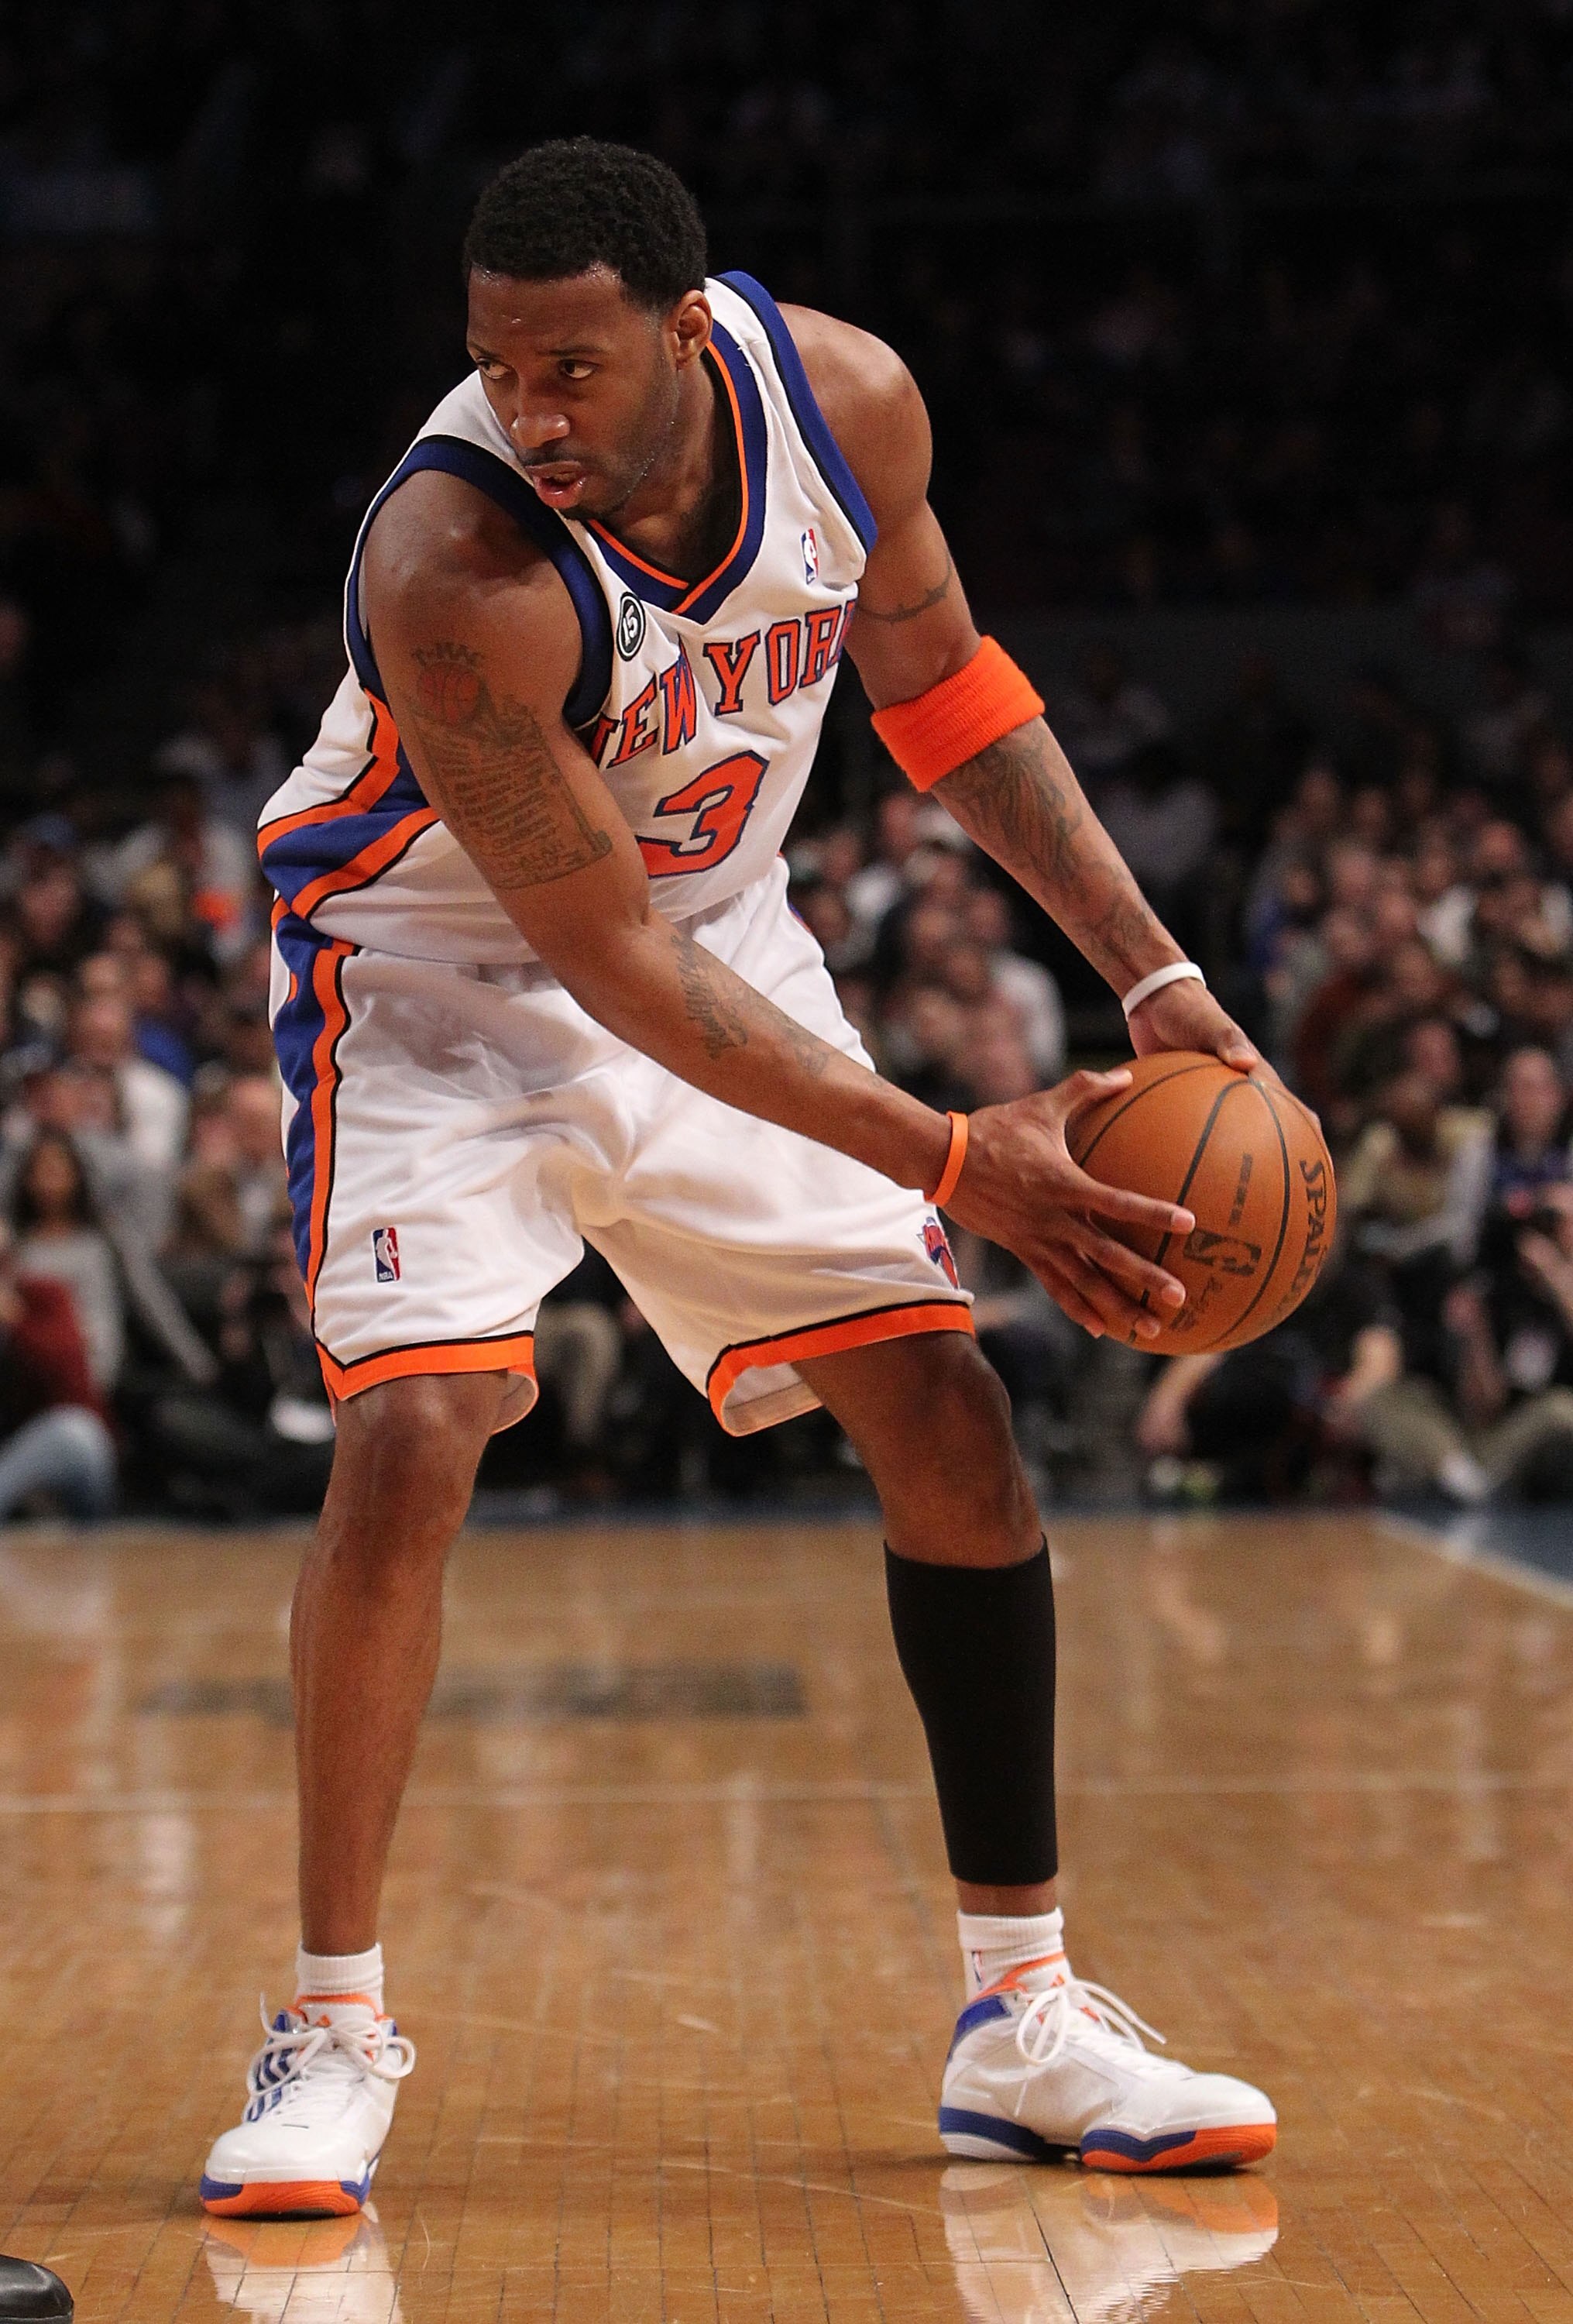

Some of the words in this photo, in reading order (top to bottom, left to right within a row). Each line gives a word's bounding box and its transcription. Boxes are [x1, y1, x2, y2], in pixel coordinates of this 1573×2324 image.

[623, 605, 638, 646] 15
[635, 750, 769, 878] 3
[1278, 1160, 1327, 1309] SPALD
